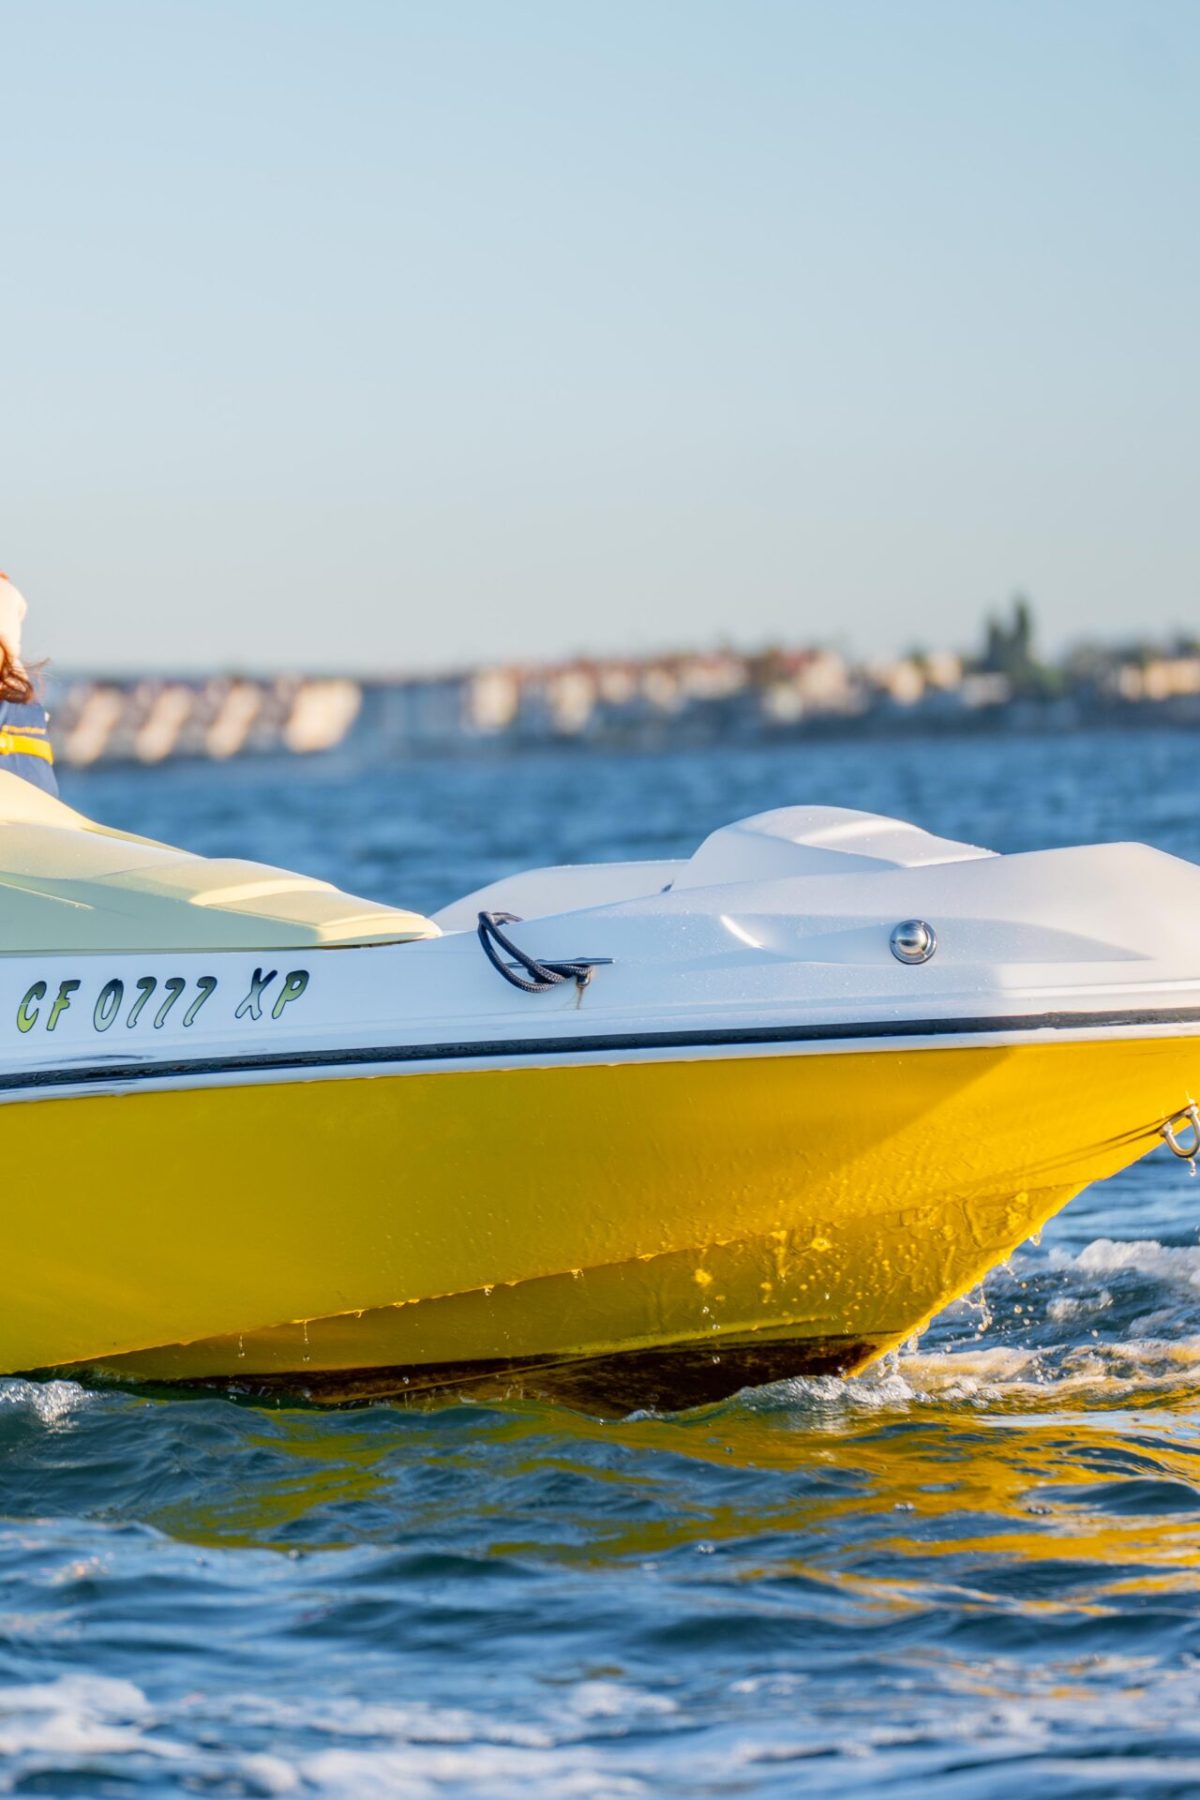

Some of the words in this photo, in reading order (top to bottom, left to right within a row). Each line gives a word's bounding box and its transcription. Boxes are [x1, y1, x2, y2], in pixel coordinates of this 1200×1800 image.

[16, 979, 81, 1033] CF
[93, 976, 217, 1032] 0777
[235, 967, 310, 1021] XP
